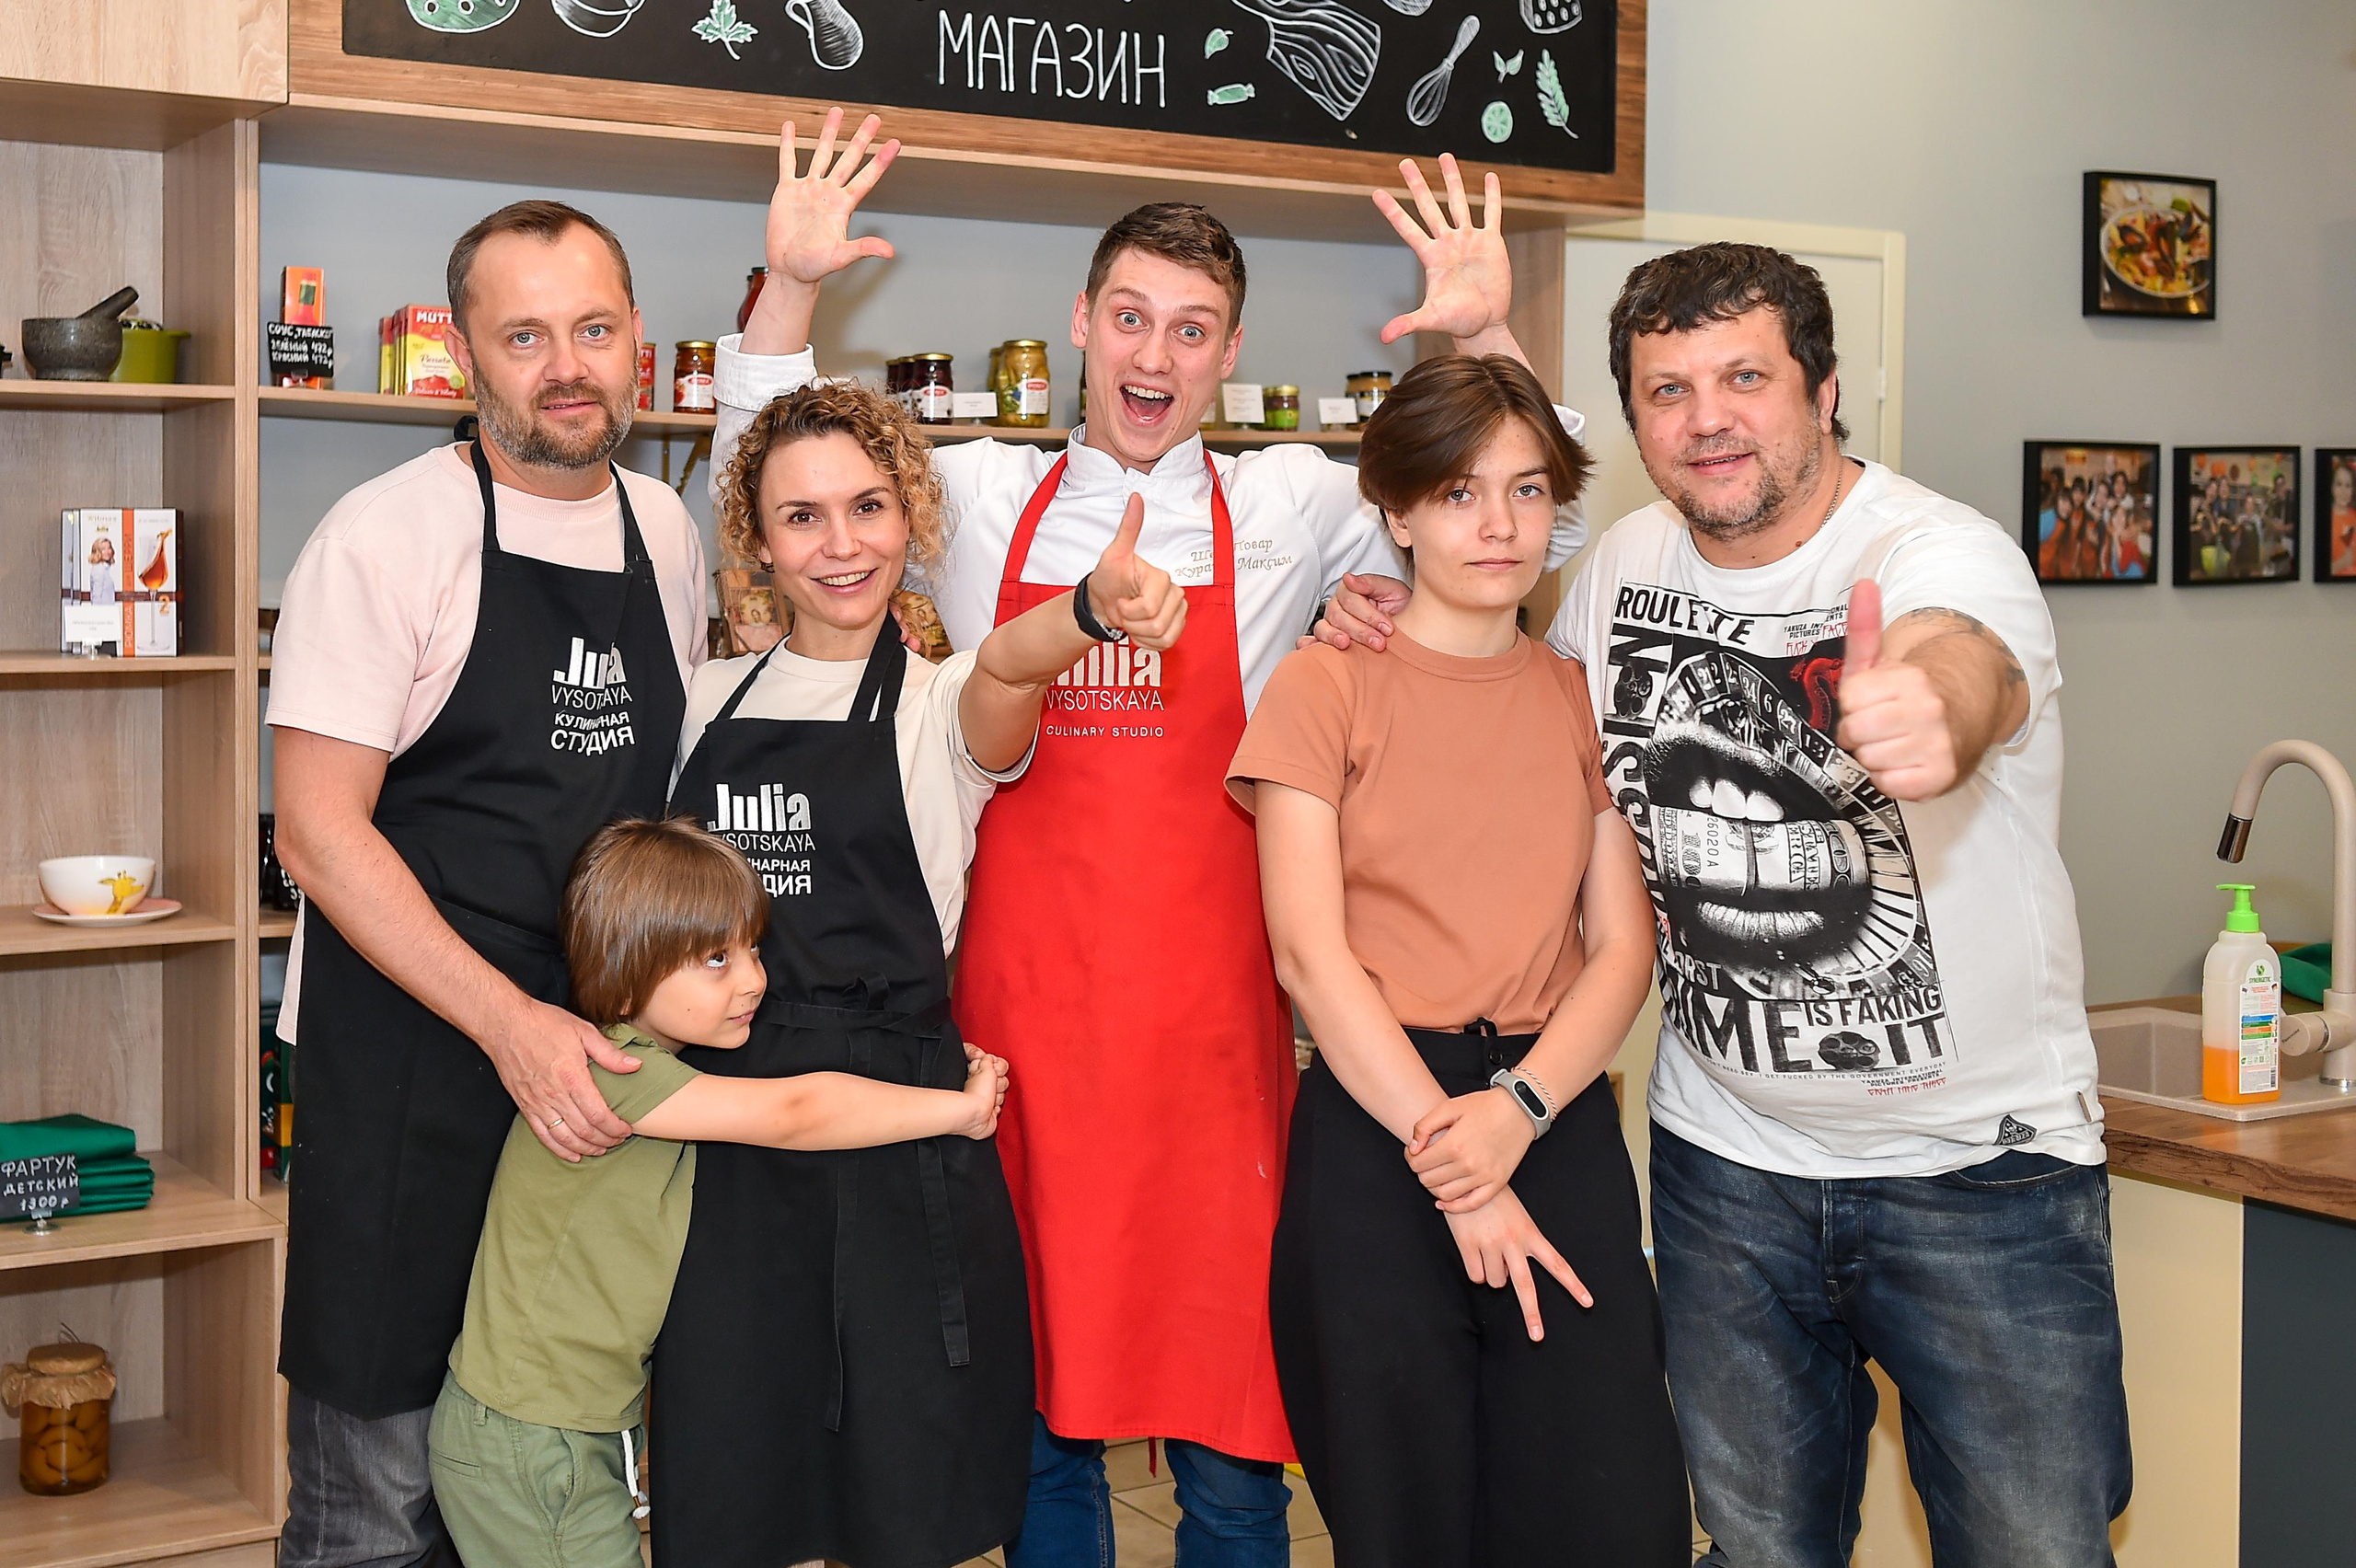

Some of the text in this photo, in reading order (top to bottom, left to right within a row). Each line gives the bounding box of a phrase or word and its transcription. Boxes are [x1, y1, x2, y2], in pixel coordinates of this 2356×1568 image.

[938, 9, 1166, 108] МАГАЗИН
[416, 310, 452, 324] MUTT
[1174, 555, 1293, 579] Кура Максим
[1615, 586, 1754, 645] ROULETE
[1789, 628, 1820, 639] PICTURES
[1045, 690, 1165, 711] VYSOTSKAYA
[1763, 693, 1773, 713] 6
[550, 725, 636, 756] СТУДИЯ
[1046, 725, 1164, 738] CULINARY STUDIO
[707, 783, 813, 832] Julia
[722, 833, 815, 853] SOTSKAYA
[757, 873, 812, 898] ДИЯ
[1673, 951, 1722, 990] ORST
[1804, 1000, 1833, 1027] IS
[1839, 985, 1942, 1026] FAKING
[1885, 1010, 1946, 1066] IT
[1850, 1070, 1906, 1079] GOVERNMENT
[1910, 1061, 1946, 1074] EVERYDAY
[1, 1155, 76, 1178] ФАРТУК
[3, 1172, 79, 1196] ДЕТСКИЙ
